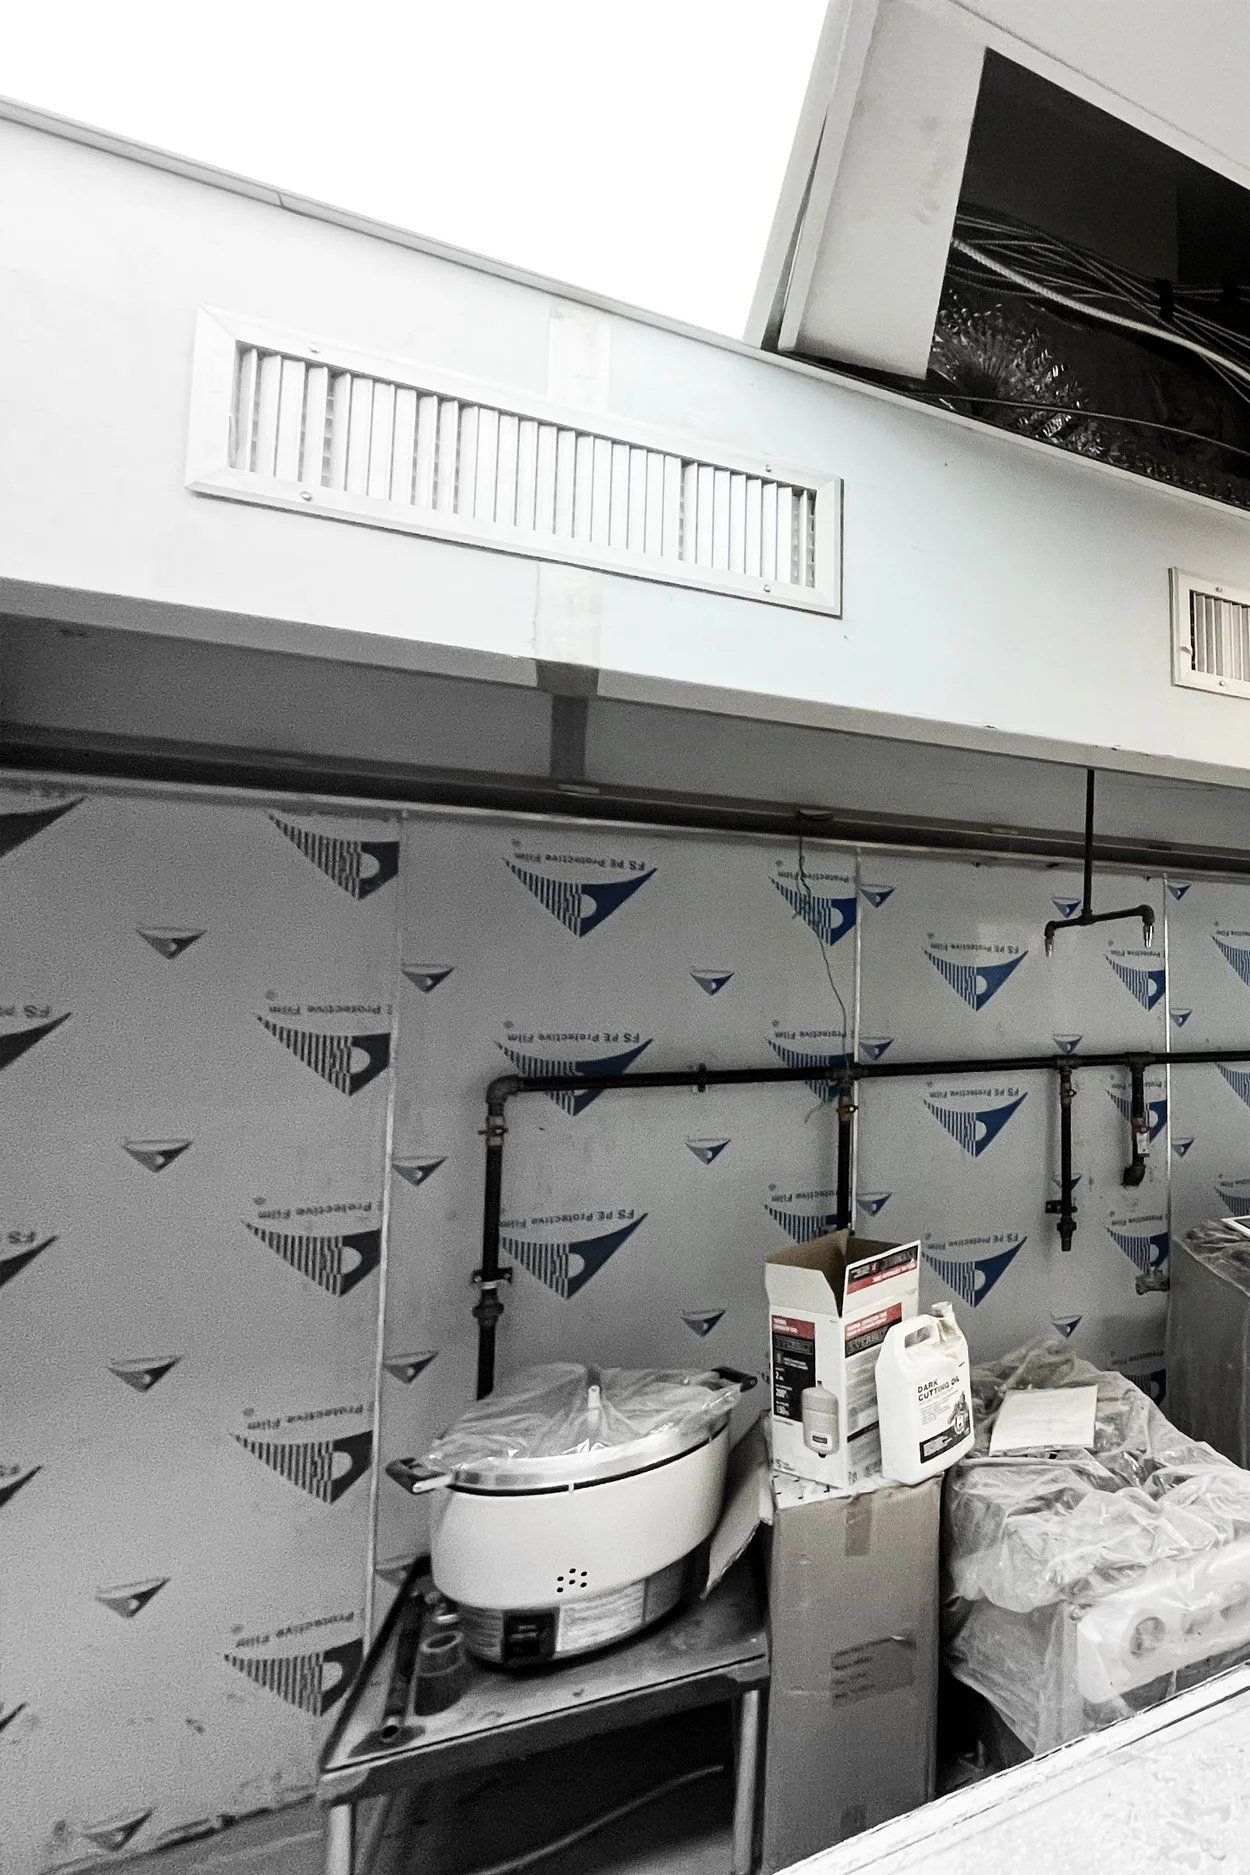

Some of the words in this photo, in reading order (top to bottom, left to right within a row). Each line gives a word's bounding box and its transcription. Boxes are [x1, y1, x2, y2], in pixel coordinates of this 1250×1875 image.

[514, 853, 541, 864] Film
[545, 854, 605, 868] Protective
[610, 859, 624, 870] PE
[628, 860, 645, 871] FS
[930, 943, 949, 951] Film
[949, 943, 992, 953] Protective
[994, 945, 1005, 953] PE
[1008, 945, 1019, 954] FS
[507, 1033, 534, 1043] Film
[538, 1032, 600, 1043] Protective
[603, 1032, 619, 1043] PE
[623, 1032, 640, 1043] FS
[775, 1031, 796, 1040] Film
[929, 1091, 948, 1099] Film
[949, 1089, 992, 1098] Protective
[993, 1088, 1005, 1097] PE
[1007, 1087, 1019, 1097] FS
[530, 1213, 594, 1225] Protective
[596, 1210, 613, 1220] PE
[617, 1209, 634, 1220] FS
[499, 1219, 526, 1229] Film
[948, 1236, 991, 1247] Protective
[993, 1235, 1004, 1244] PE
[1006, 1233, 1019, 1243] FS
[927, 1242, 946, 1251] Film
[917, 1380, 939, 1394] DARK
[918, 1382, 950, 1402] CUTTING
